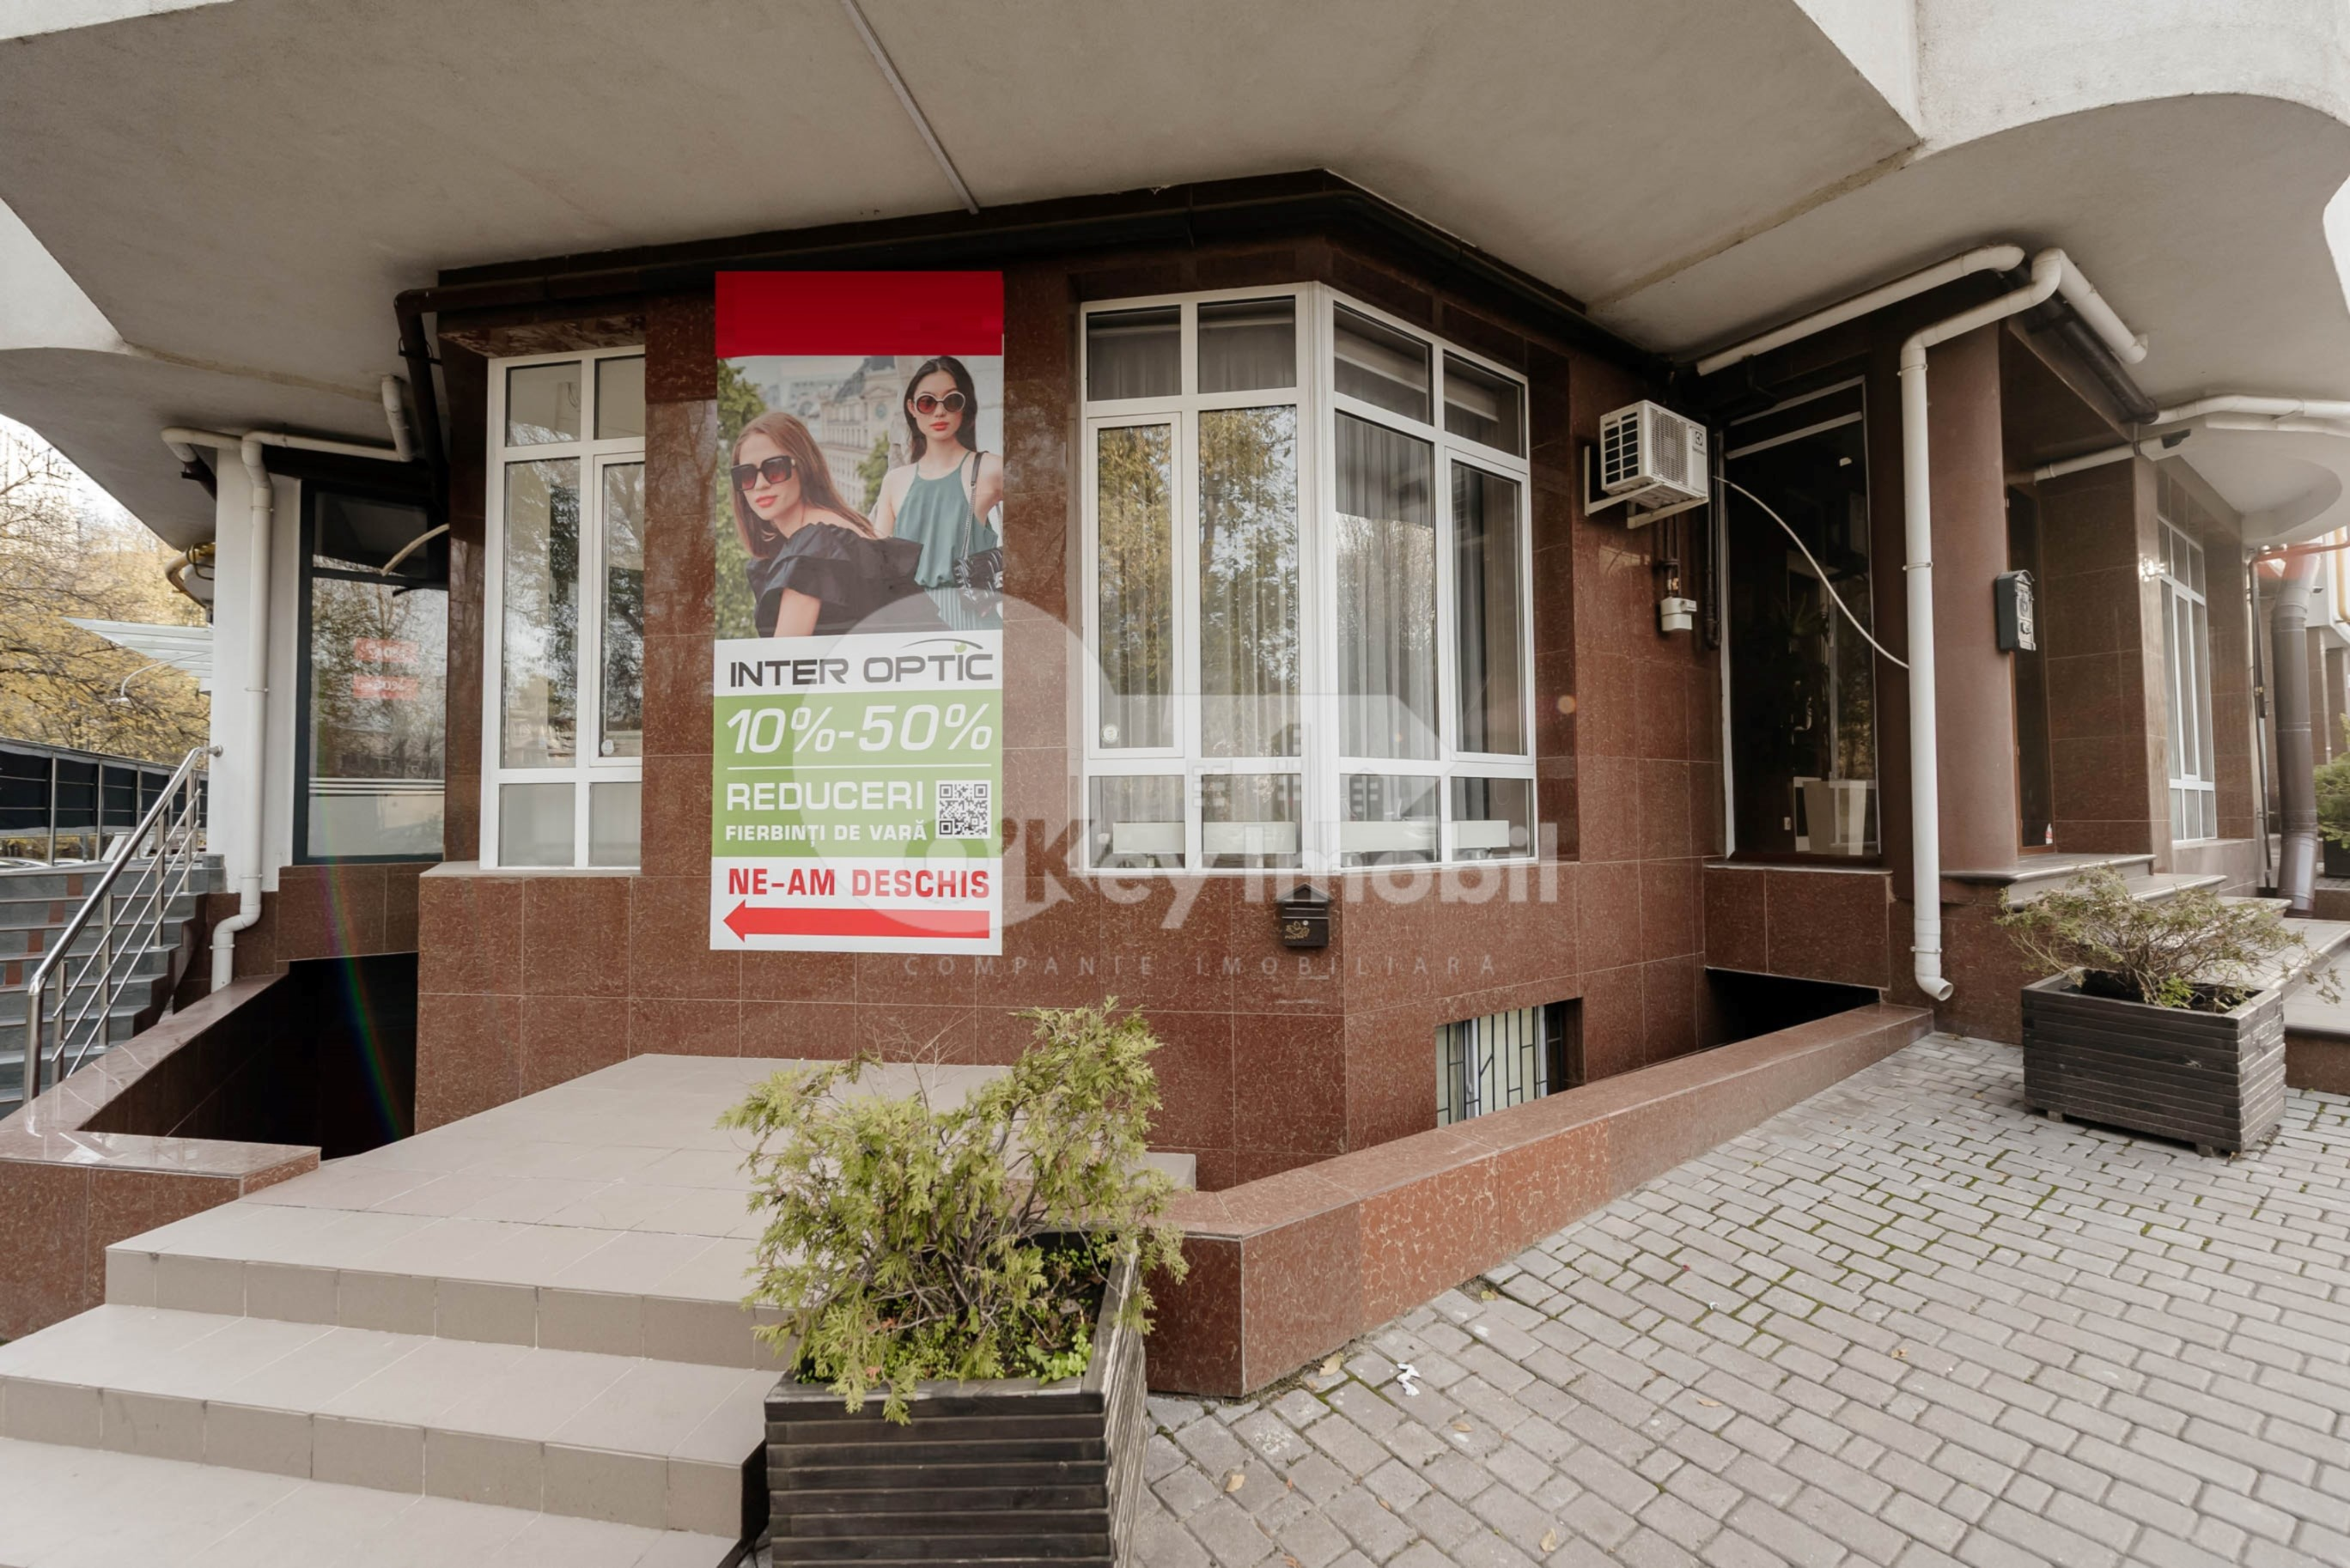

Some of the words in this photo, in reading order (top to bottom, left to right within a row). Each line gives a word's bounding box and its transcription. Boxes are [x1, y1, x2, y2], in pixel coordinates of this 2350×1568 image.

[730, 659, 849, 688] INTER
[864, 653, 993, 683] OPTIC
[727, 702, 993, 754] 10%-50%
[726, 781, 924, 811] REDUCERI
[834, 825, 861, 841] DE
[869, 820, 928, 841] VARĂ
[728, 868, 836, 896] NE-AM
[852, 869, 989, 898] DESCHIS
